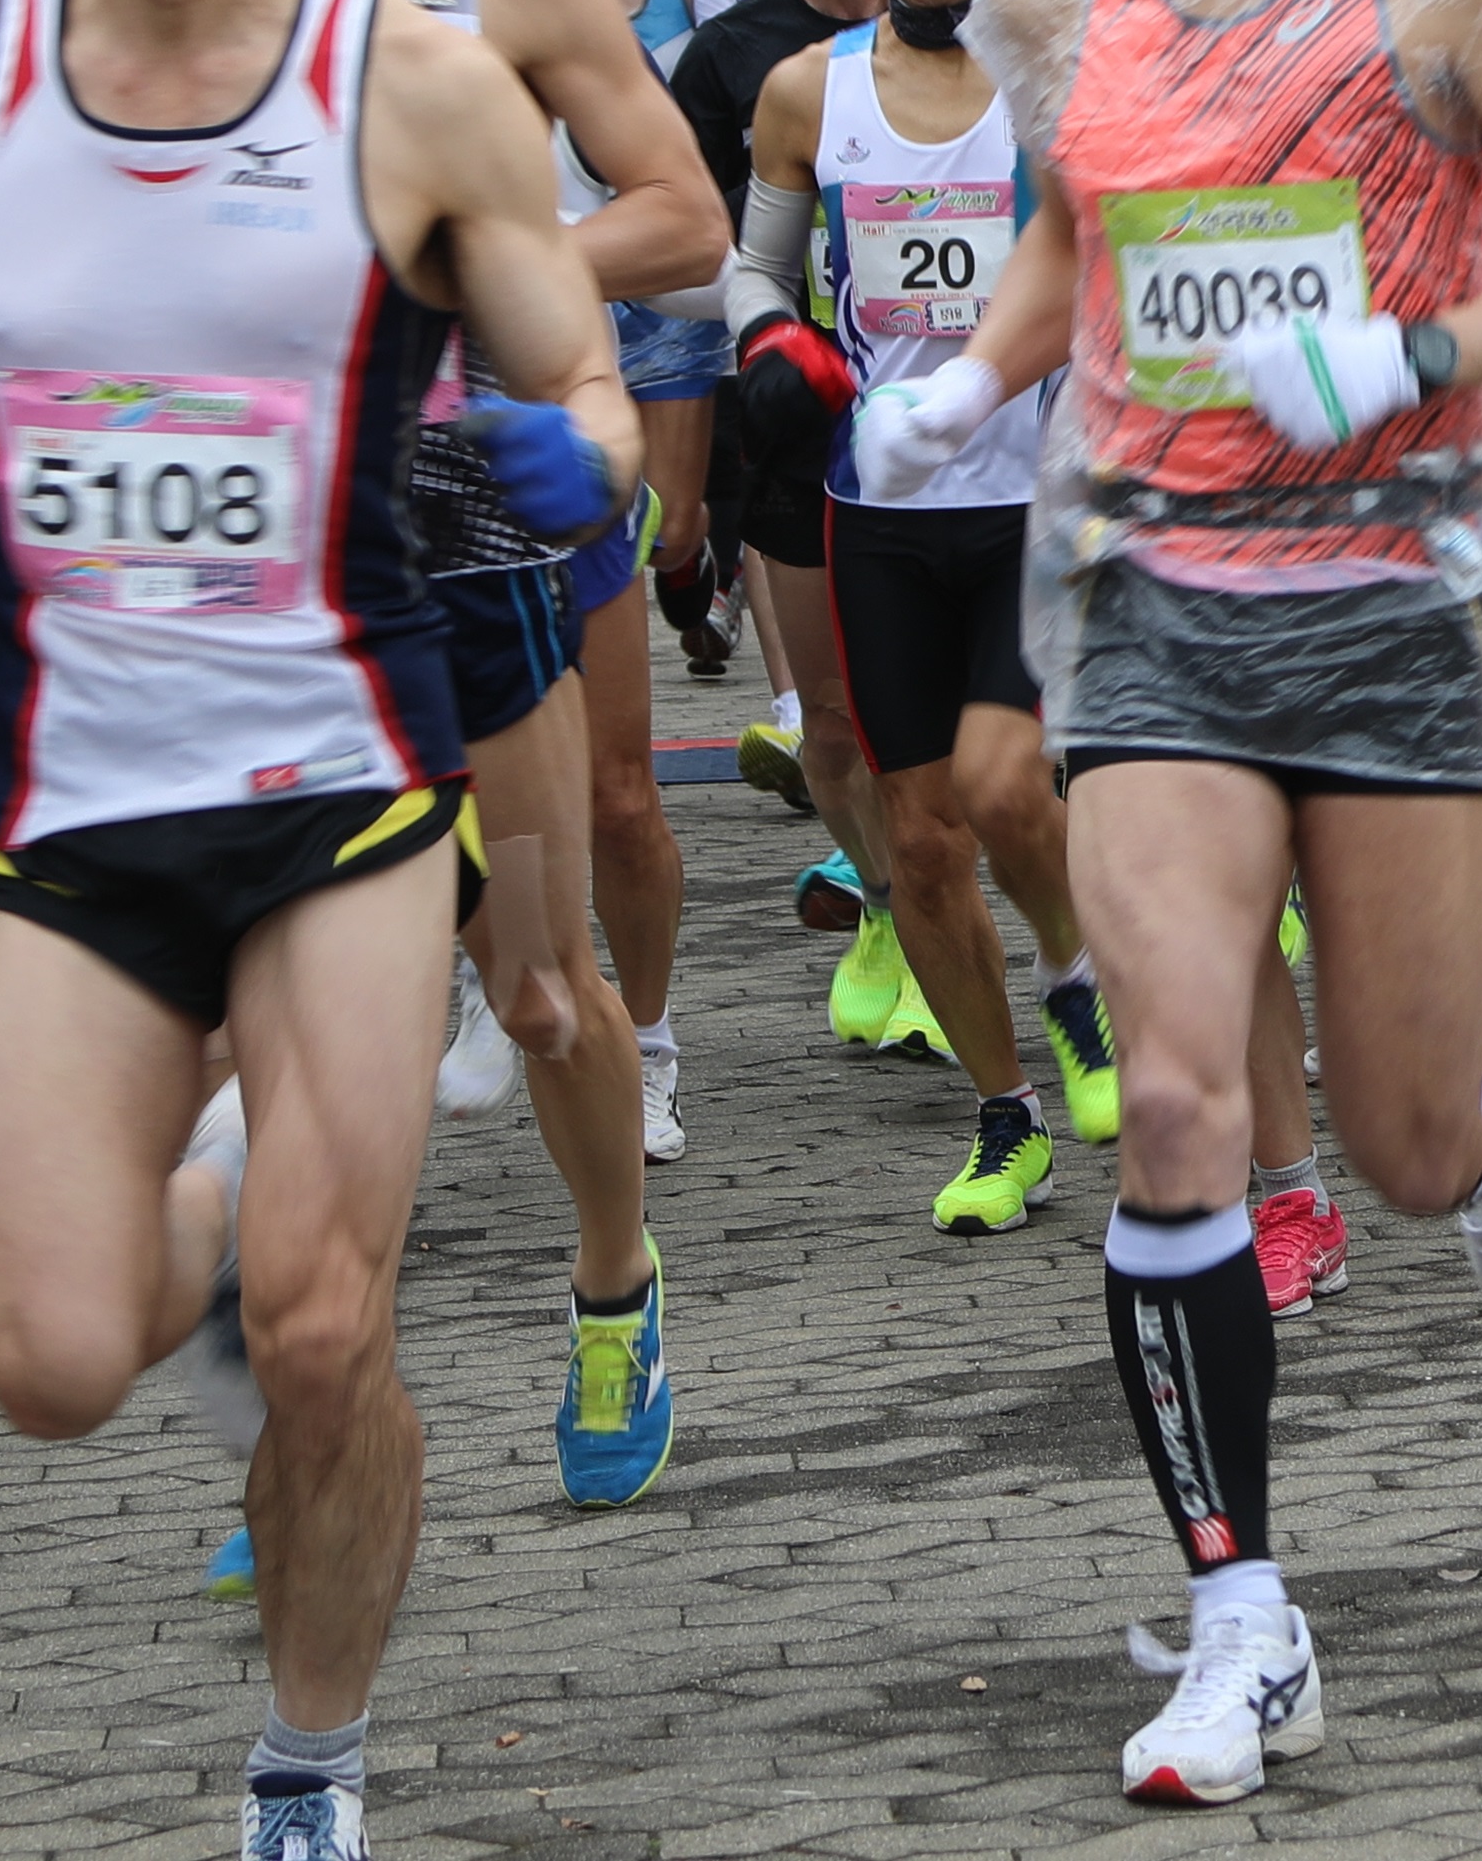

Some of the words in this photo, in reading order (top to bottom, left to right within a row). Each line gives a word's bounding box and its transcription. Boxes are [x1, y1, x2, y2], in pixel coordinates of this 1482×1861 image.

[862, 223, 885, 236] Half
[900, 238, 975, 290] 20
[1139, 265, 1329, 342] 40039
[26, 457, 266, 545] 5108
